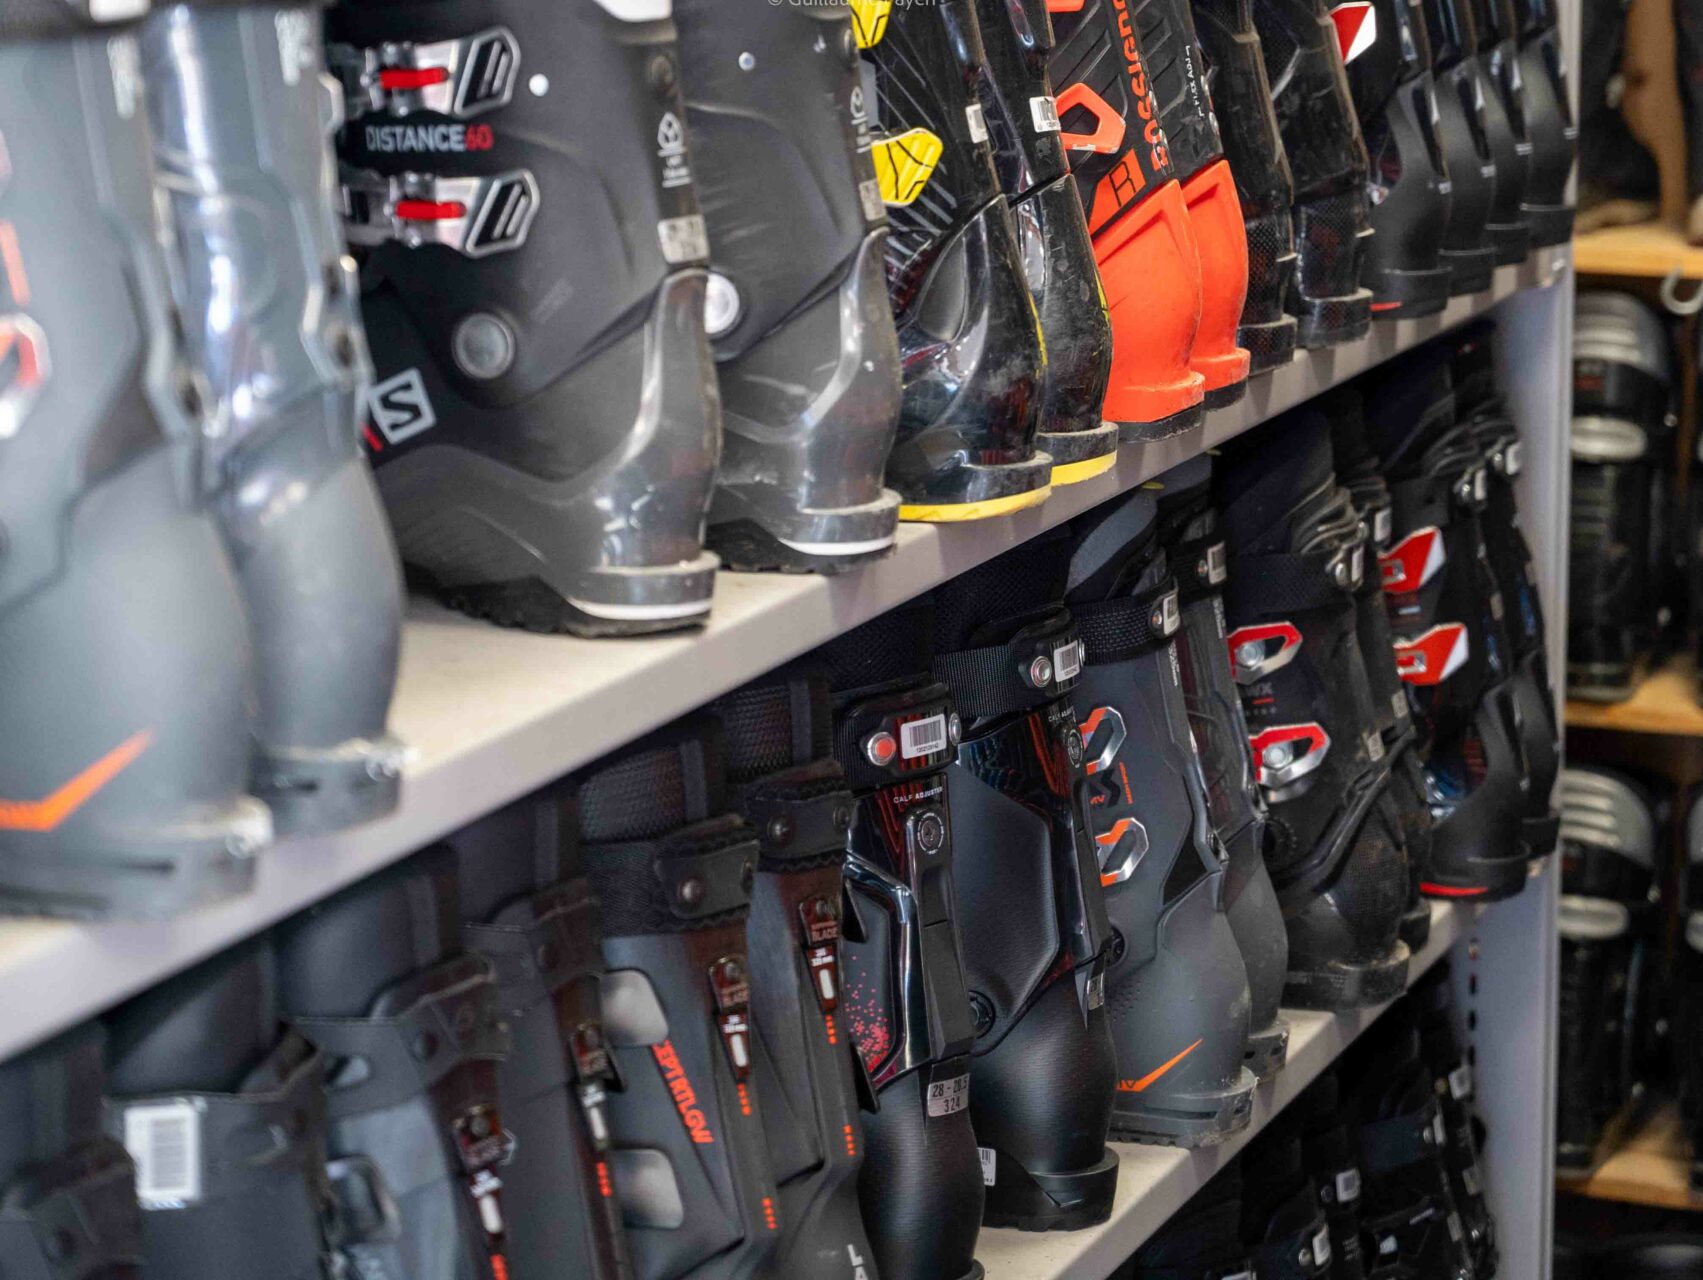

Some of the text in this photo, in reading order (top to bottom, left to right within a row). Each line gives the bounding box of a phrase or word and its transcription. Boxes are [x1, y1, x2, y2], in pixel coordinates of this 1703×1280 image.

[893, 794, 913, 804] CALF
[932, 1083, 944, 1098] 28
[943, 1095, 960, 1112] 324
